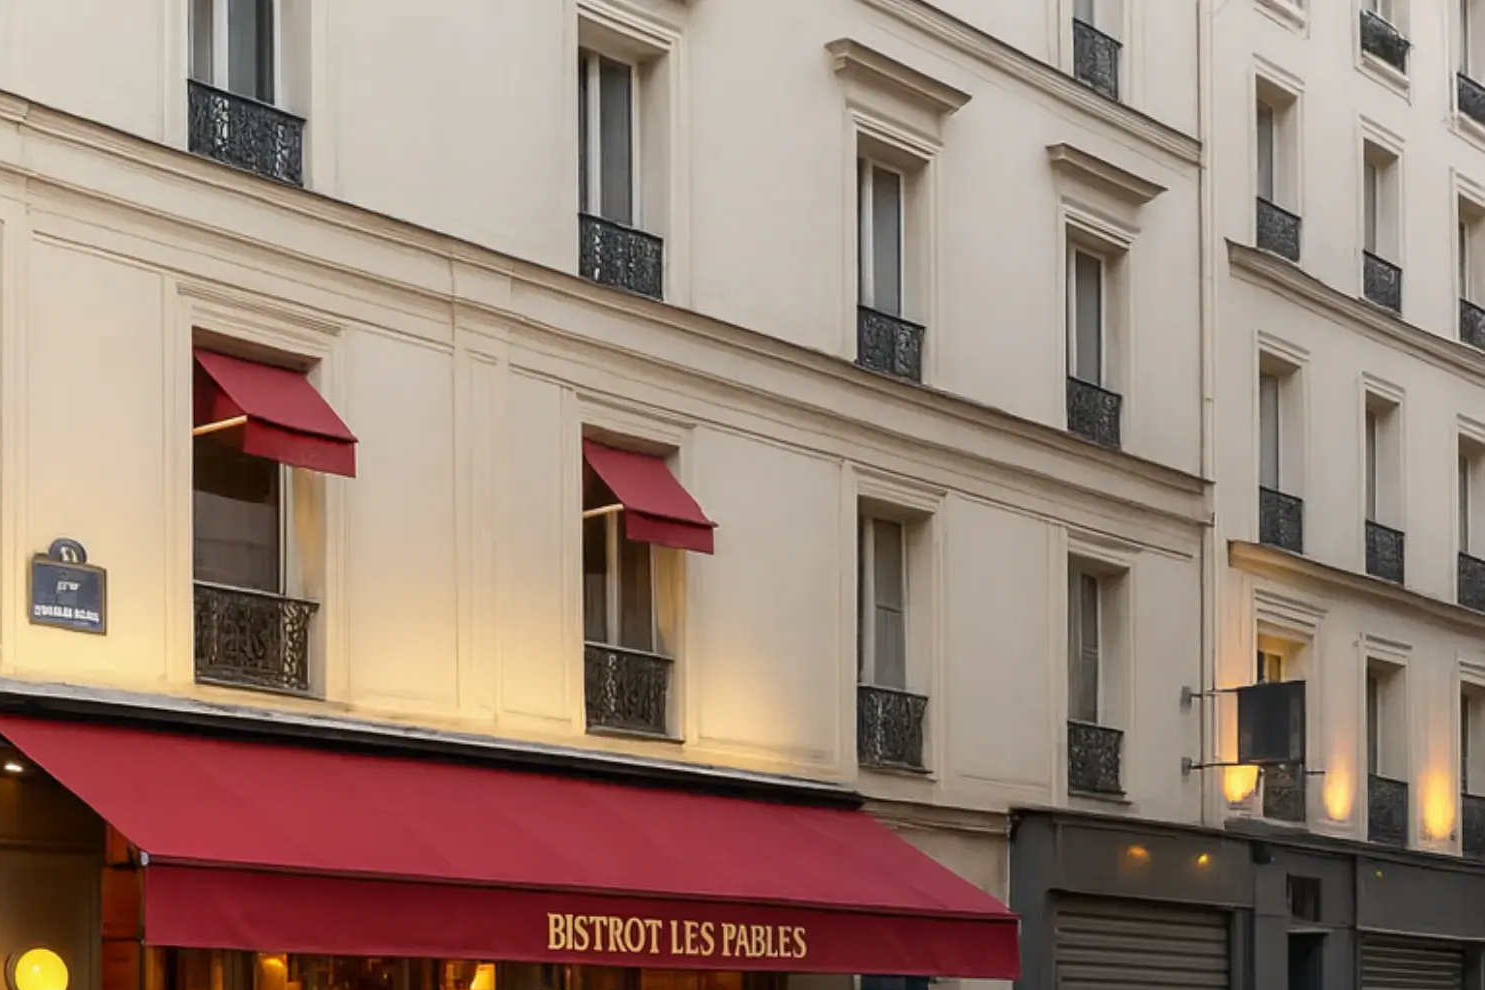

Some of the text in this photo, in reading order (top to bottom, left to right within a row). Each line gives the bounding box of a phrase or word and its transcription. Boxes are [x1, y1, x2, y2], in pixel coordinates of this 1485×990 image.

[547, 912, 807, 958] BISTROT LES PABLES
